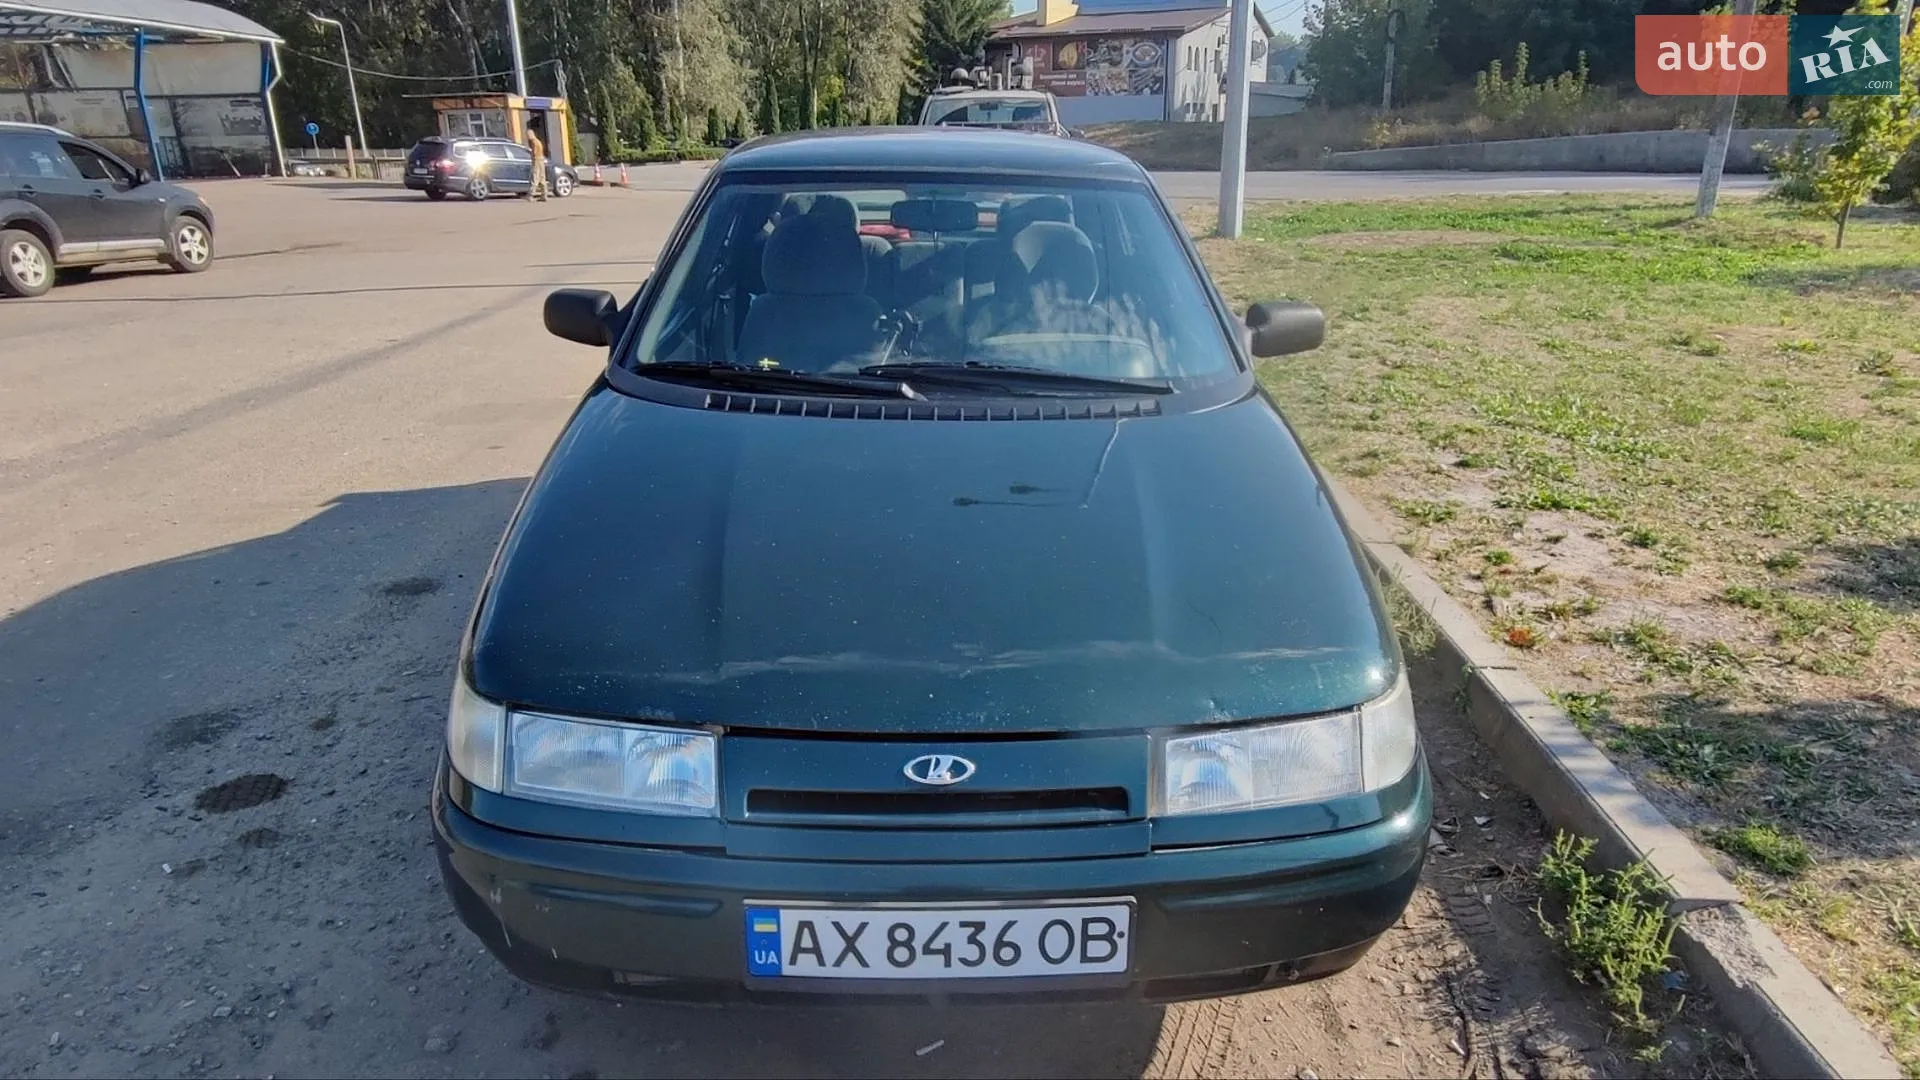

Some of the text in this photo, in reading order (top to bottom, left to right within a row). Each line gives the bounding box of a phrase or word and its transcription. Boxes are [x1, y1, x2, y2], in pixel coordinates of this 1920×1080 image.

[755, 950, 779, 966] UA
[788, 916, 1119, 968] AX 8436 OB
